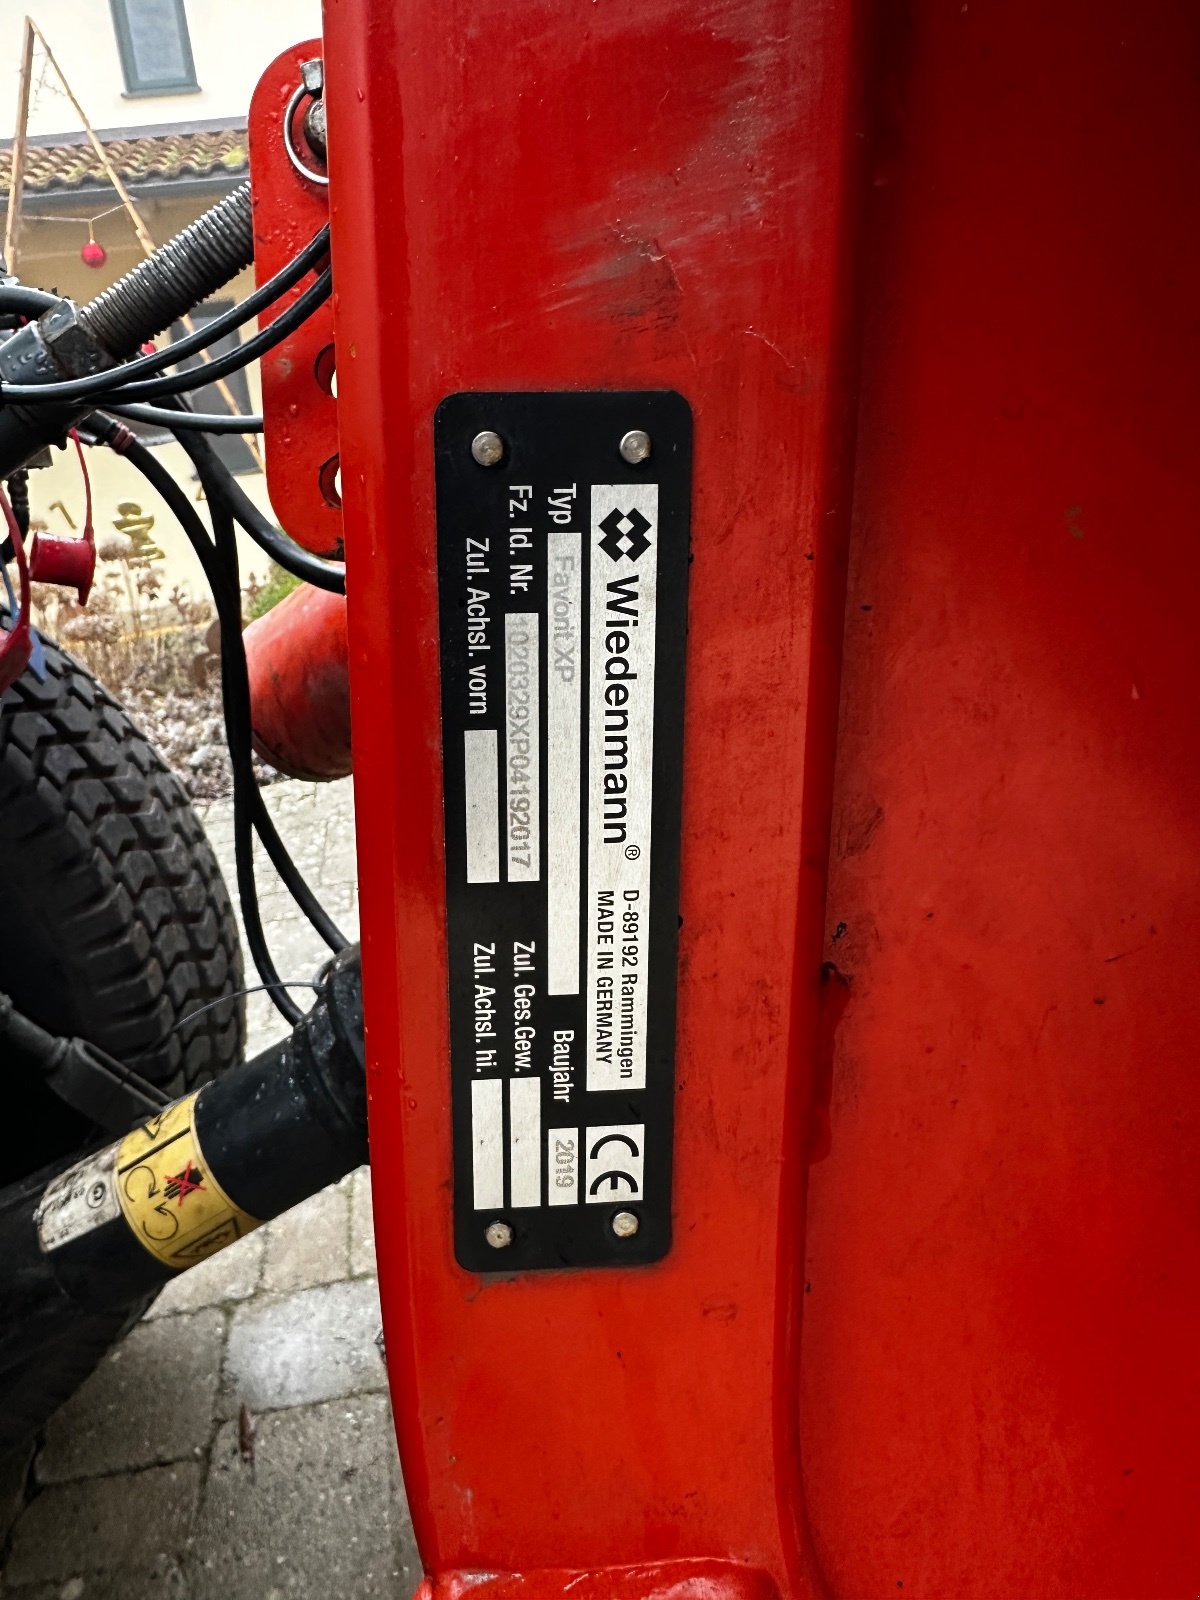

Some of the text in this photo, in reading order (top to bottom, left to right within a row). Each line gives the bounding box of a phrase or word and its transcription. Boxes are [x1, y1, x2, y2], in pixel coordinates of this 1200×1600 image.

[509, 486, 532, 517] Fz.
[510, 528, 532, 555] Id.
[548, 483, 576, 524] Typ
[466, 538, 490, 714] Zul. Achsl. vorn
[510, 565, 533, 594] Nr.
[552, 648, 575, 684] XP
[474, 943, 497, 1072] Zul. Achsl. hi.
[514, 941, 535, 1072] Zul. Ges.Gew.
[596, 891, 614, 1063] MADE IN GERMANY
[617, 890, 639, 1078] D-89192 Rammingen
[549, 1030, 575, 1190] Baujahr 2019
